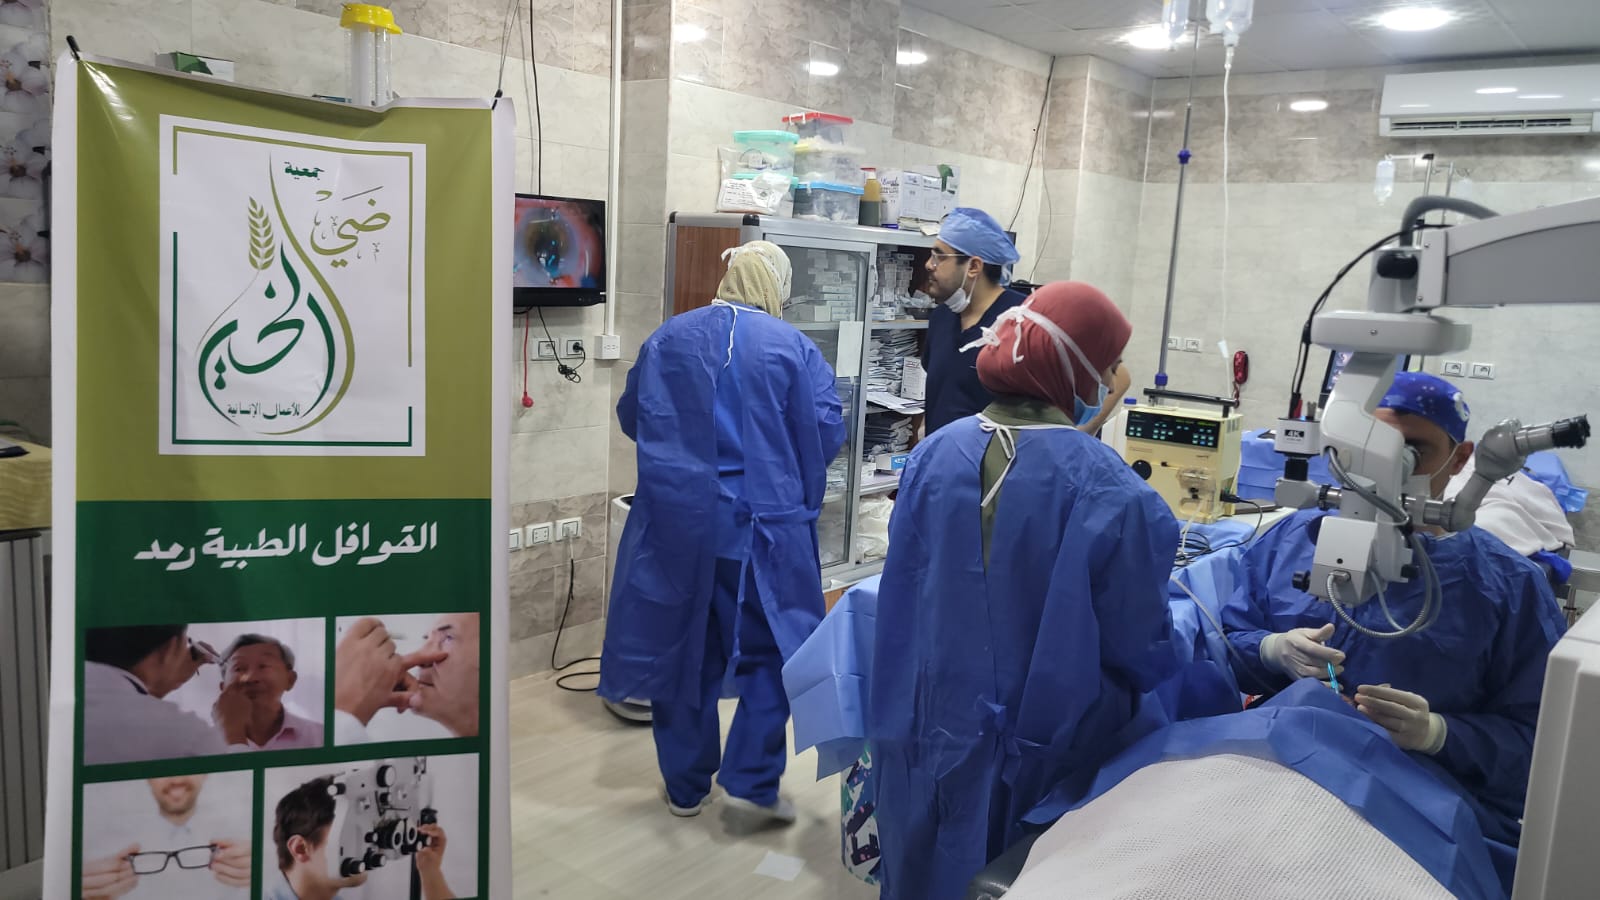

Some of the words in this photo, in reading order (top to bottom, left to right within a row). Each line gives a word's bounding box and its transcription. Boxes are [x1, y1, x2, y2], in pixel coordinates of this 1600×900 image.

[284, 161, 324, 180] جمعية
[134, 539, 195, 571] رمد
[202, 523, 307, 569] الطبية
[312, 521, 437, 566] القوافل
